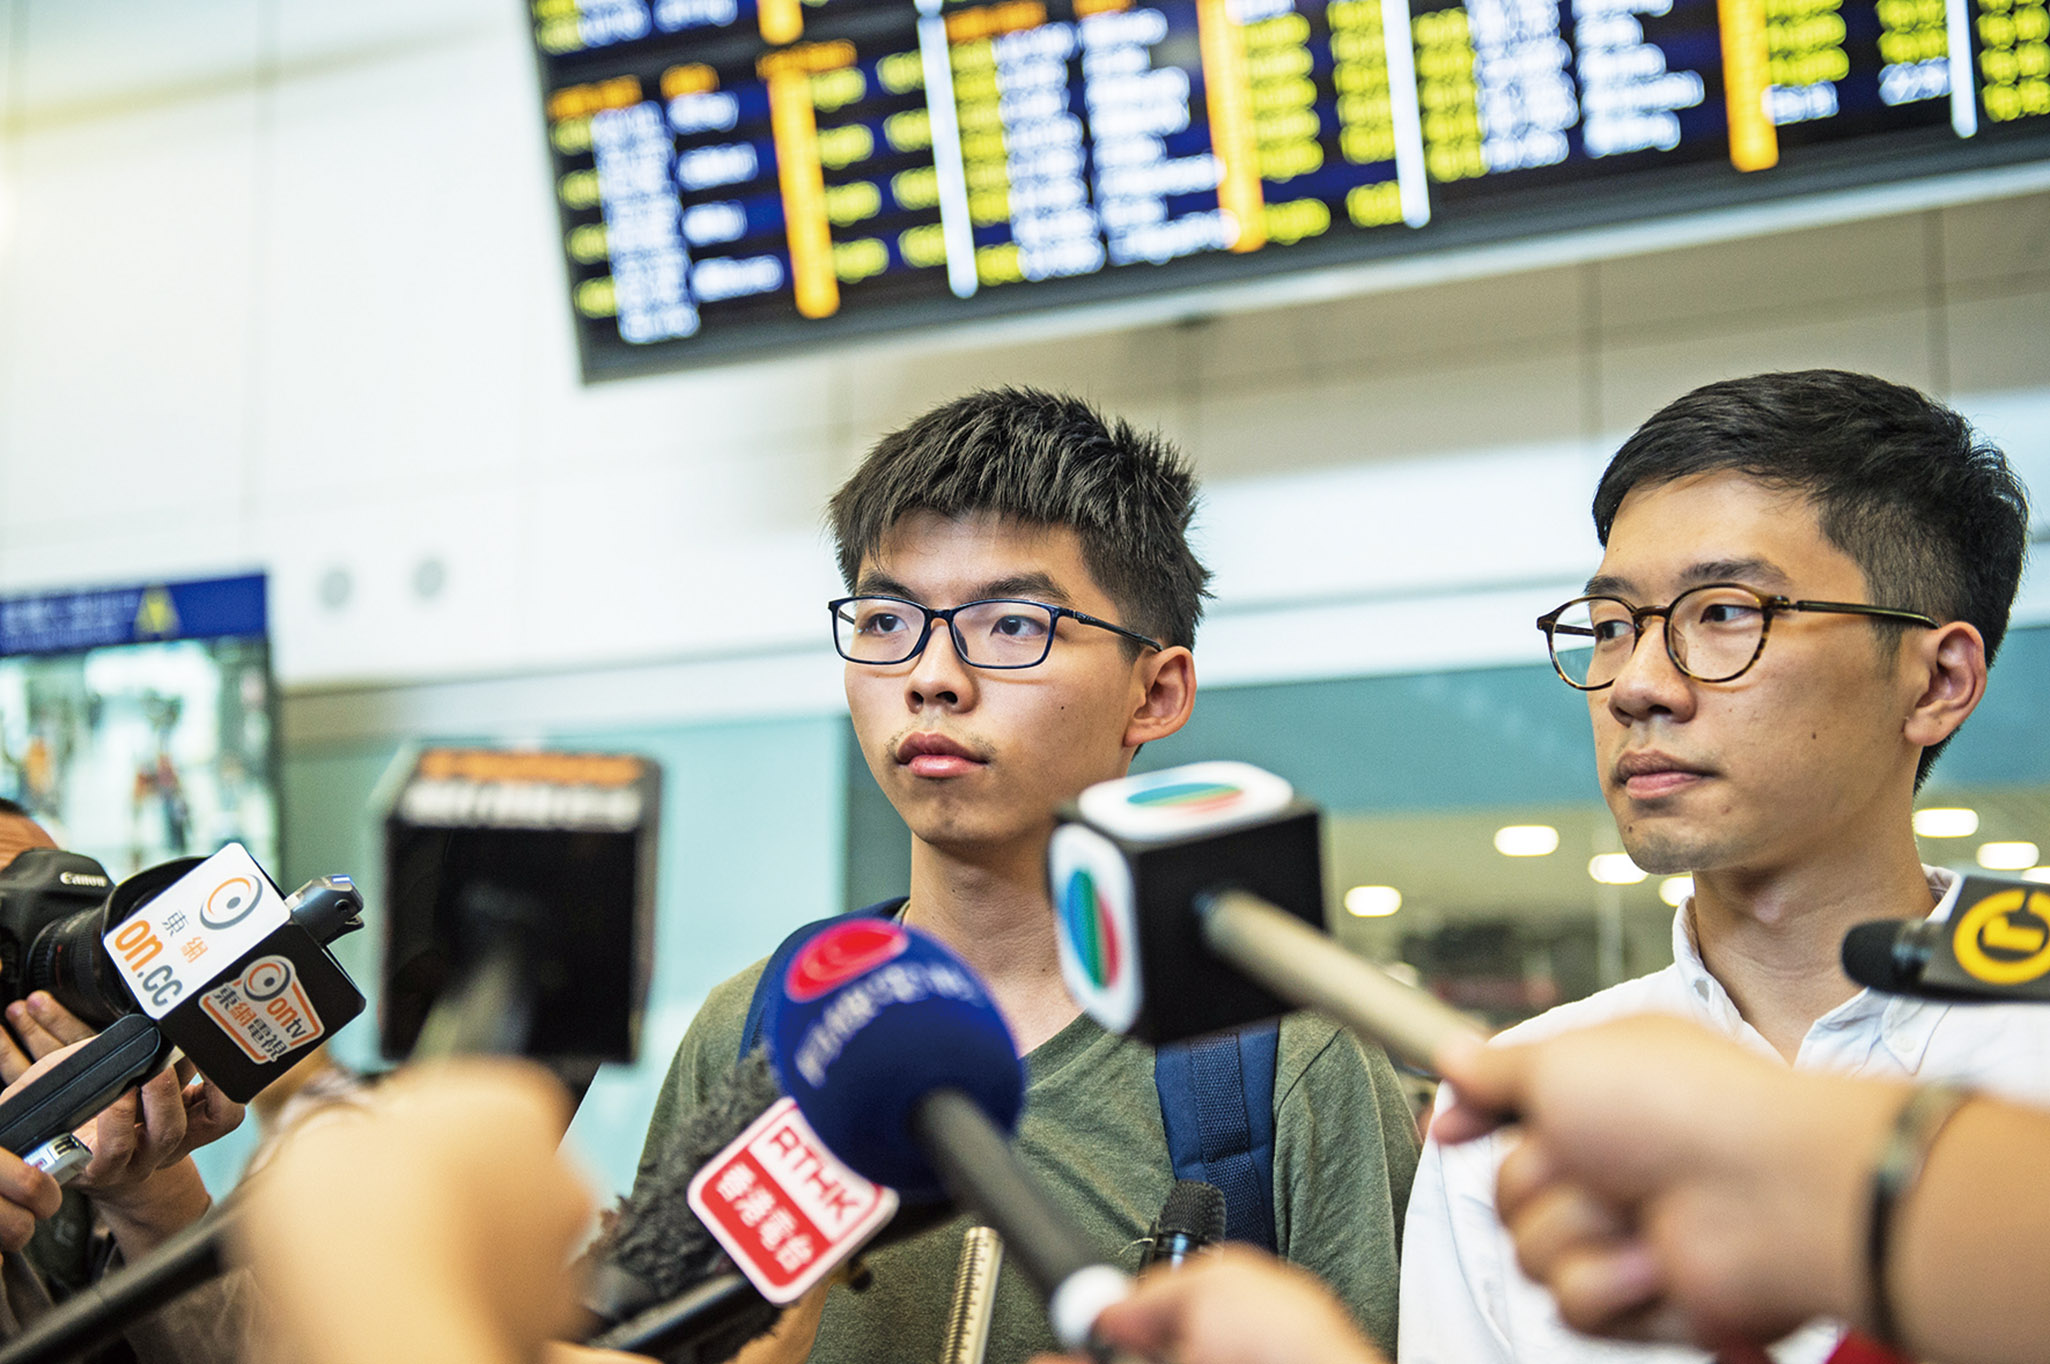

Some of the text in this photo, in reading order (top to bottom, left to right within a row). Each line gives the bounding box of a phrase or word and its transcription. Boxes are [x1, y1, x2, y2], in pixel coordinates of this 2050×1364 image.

[60, 871, 108, 888] Canon
[115, 920, 183, 1007] on.cc
[213, 985, 288, 1060] 東網電視
[768, 1124, 860, 1222] RTHK
[714, 1161, 815, 1275] 香港電台
